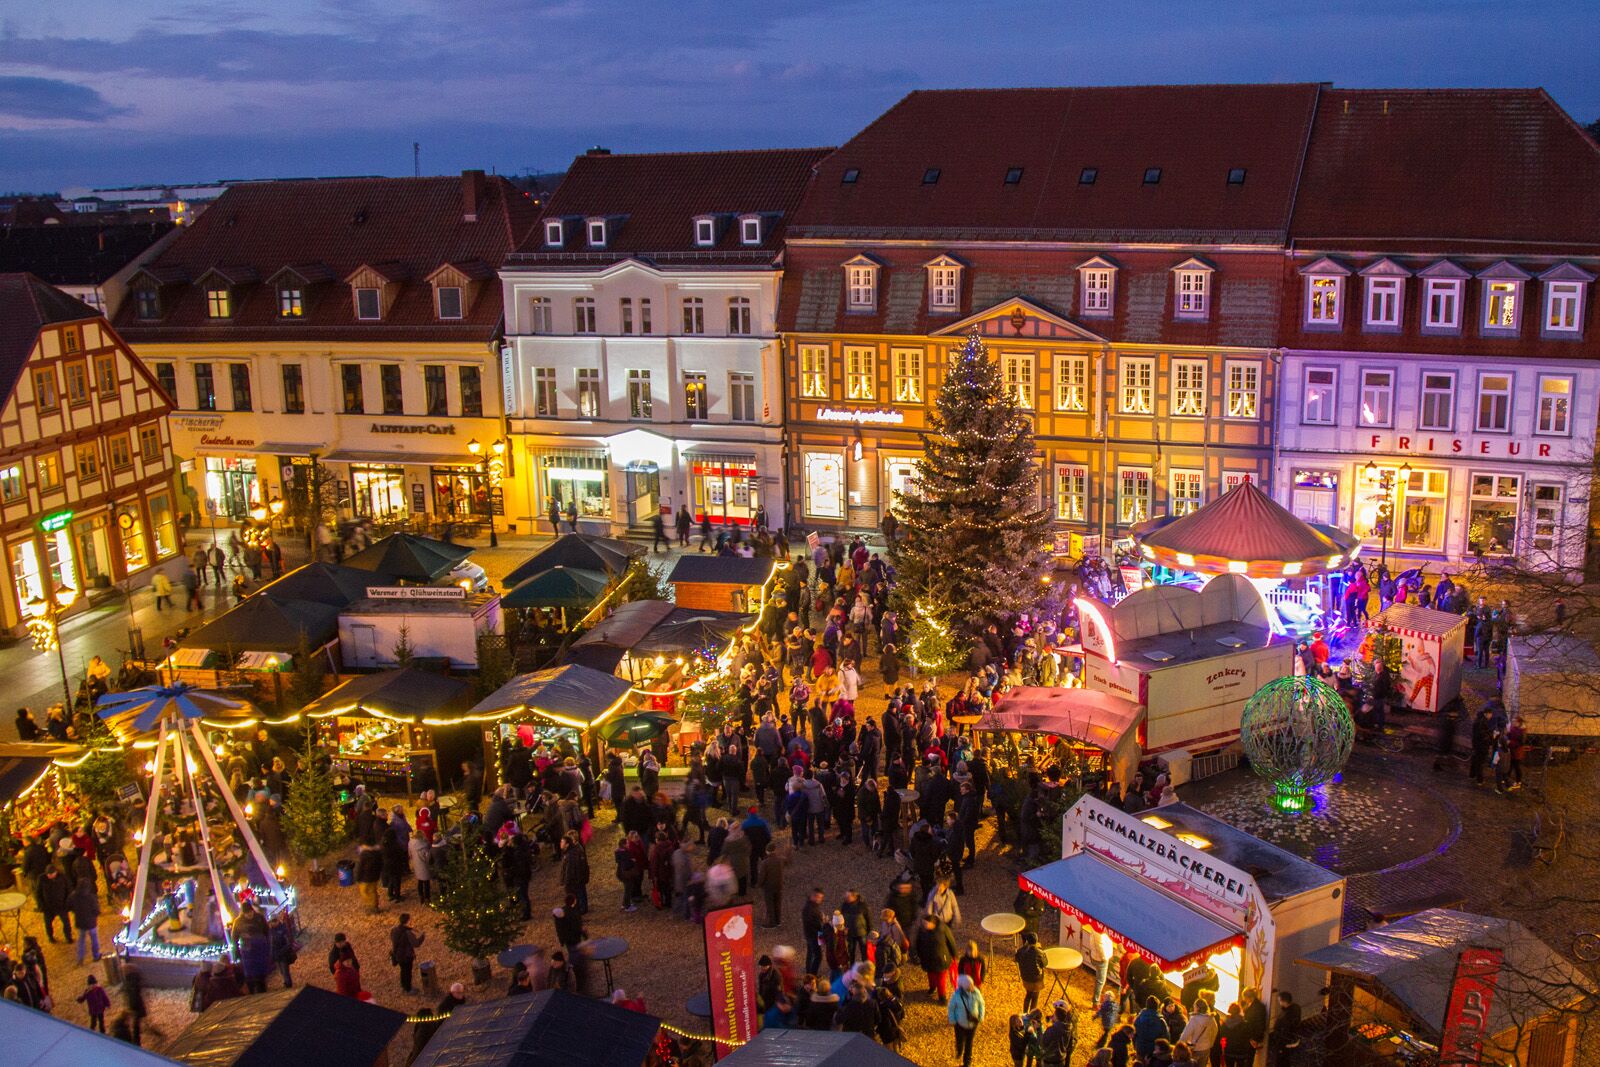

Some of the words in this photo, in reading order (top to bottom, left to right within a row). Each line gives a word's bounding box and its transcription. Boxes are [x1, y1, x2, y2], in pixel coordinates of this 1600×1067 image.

[200, 433, 235, 446] Cinderella
[1371, 435, 1551, 457] FRISEUR
[410, 588, 463, 597] Glühweinstand
[1206, 667, 1246, 685] Zenker's
[1087, 808, 1245, 898] SCHMALZBÄCKEREI
[1026, 880, 1053, 901] WARME
[1055, 897, 1084, 920] MUTZEN
[1097, 922, 1126, 947] WARME
[1126, 939, 1162, 965] MUTZEN
[1180, 952, 1203, 967] WARME
